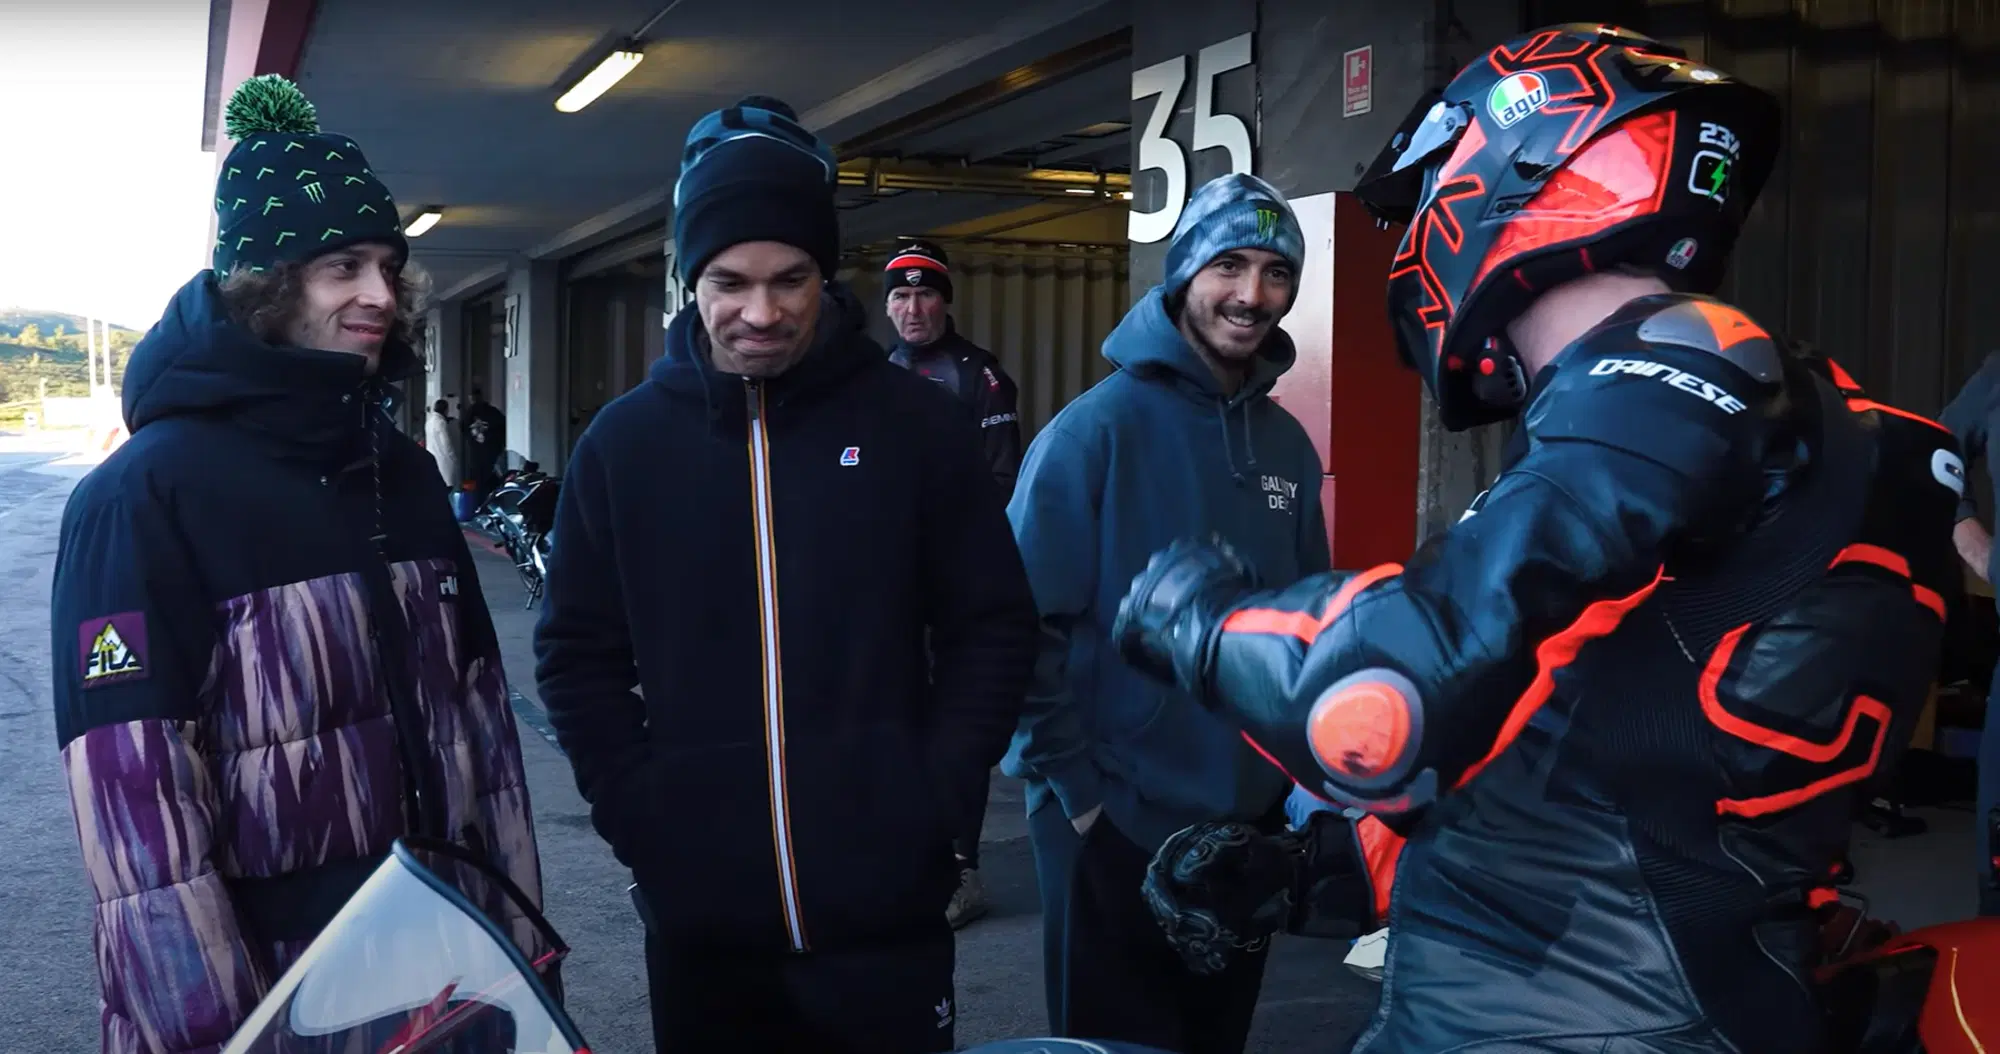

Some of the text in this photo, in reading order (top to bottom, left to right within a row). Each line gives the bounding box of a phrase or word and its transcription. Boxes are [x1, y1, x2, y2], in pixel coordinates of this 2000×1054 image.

[1503, 89, 1542, 121] agv
[1128, 32, 1252, 243] 35
[1588, 358, 1747, 414] DAINESE
[84, 647, 145, 677] FILA
